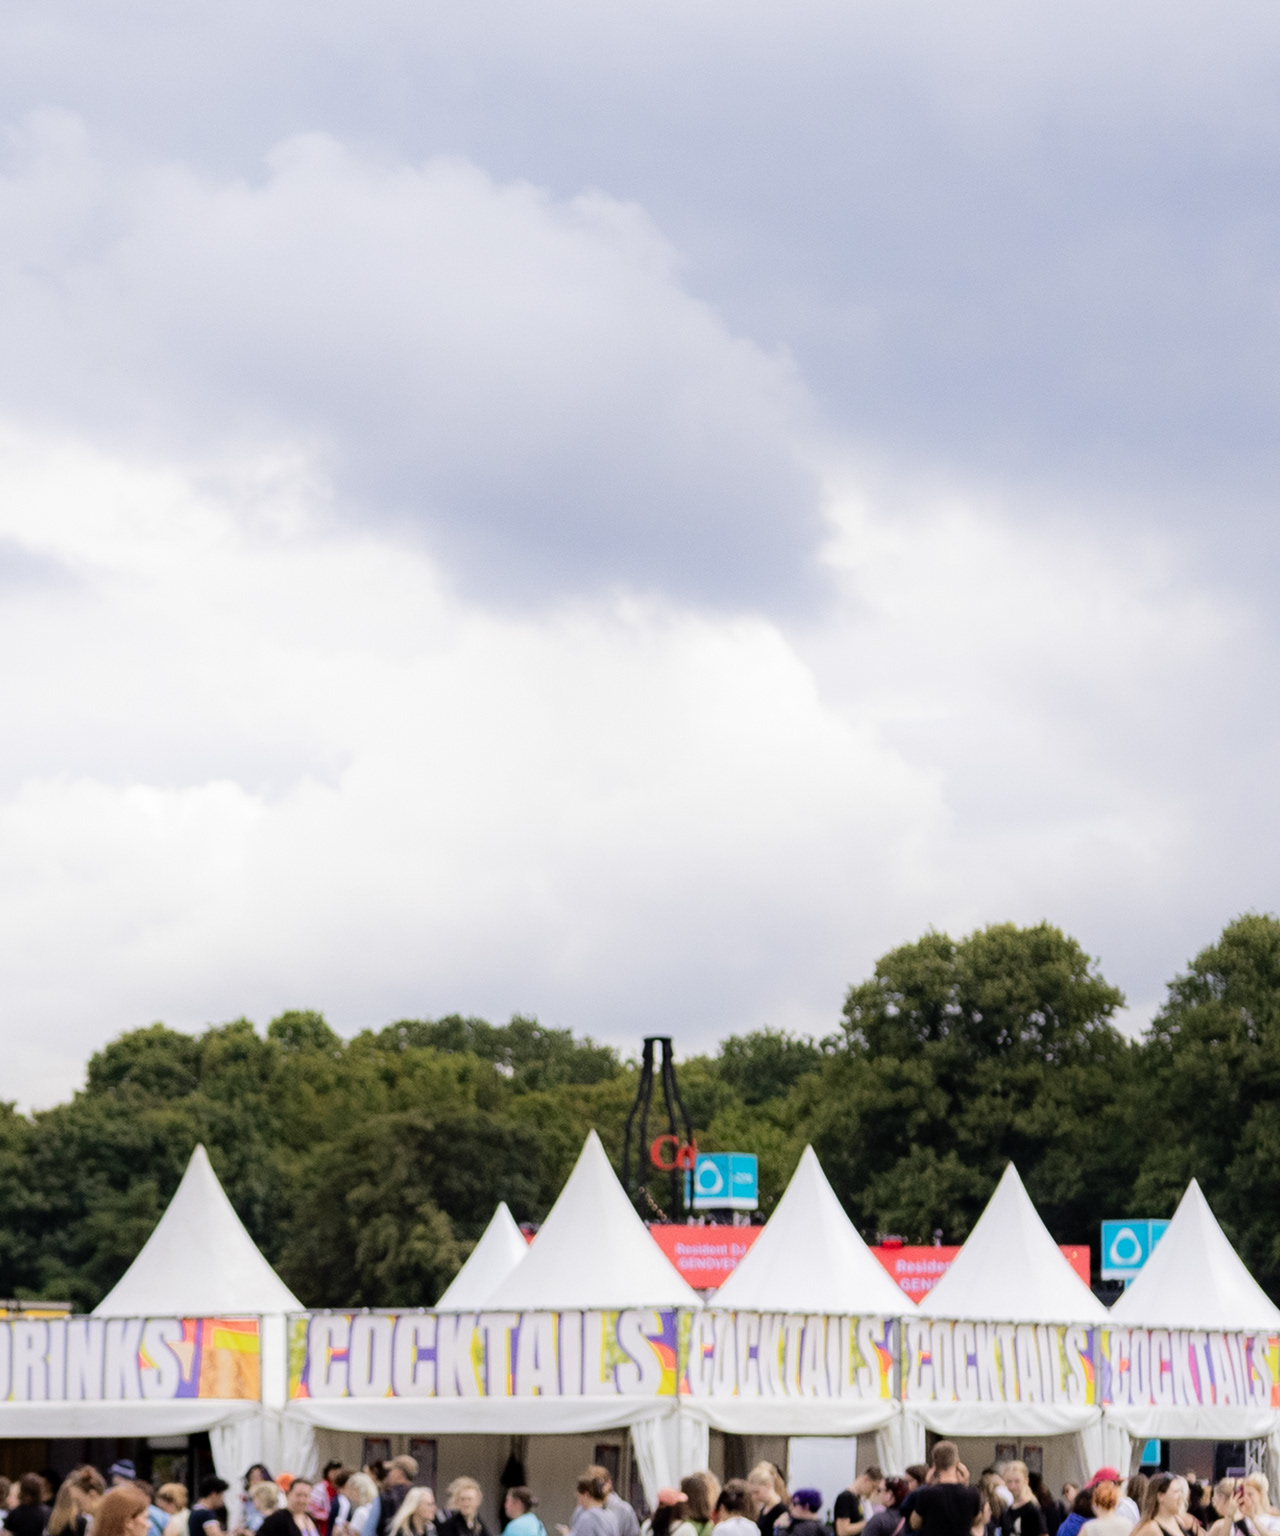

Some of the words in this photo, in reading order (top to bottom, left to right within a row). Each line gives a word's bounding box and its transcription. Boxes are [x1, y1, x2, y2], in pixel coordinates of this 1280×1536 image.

[675, 1243, 728, 1255] Resident
[731, 1243, 747, 1255] DJ
[308, 1311, 663, 1397] COCKTAILS
[689, 1312, 886, 1398] COCKTAILS
[905, 1320, 1088, 1403] COCKTAILS
[1109, 1328, 1271, 1408] COCKTAILS
